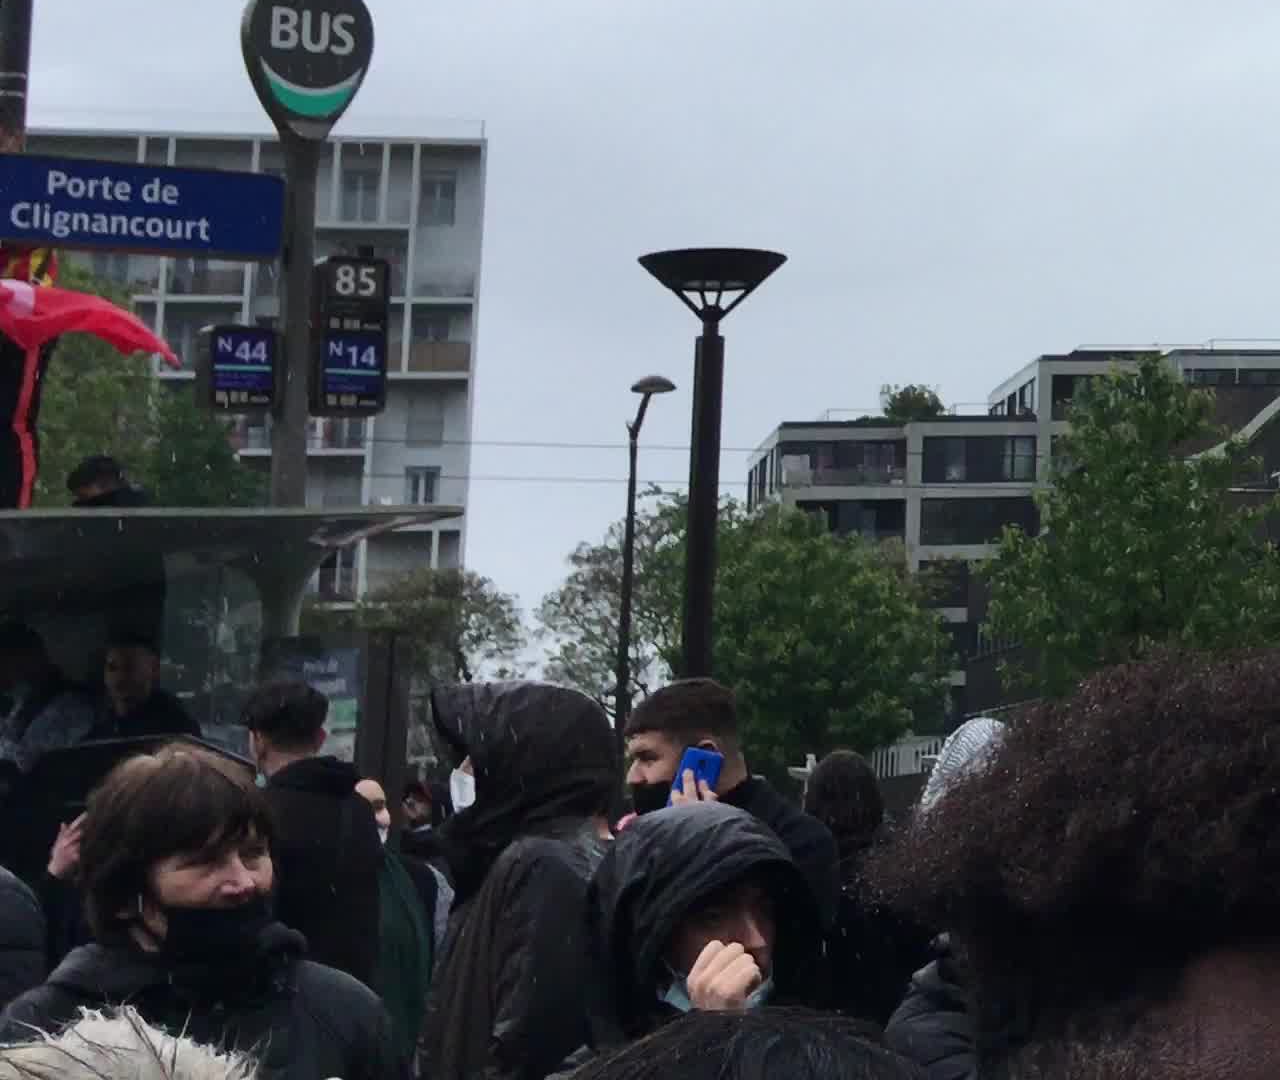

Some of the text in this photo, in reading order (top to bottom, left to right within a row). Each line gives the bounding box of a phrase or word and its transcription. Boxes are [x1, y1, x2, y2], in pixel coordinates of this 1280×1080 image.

[271, 5, 355, 55] BUS
[47, 170, 179, 204] Porte de
[10, 202, 210, 241] Clignancourt
[335, 265, 376, 296] 85
